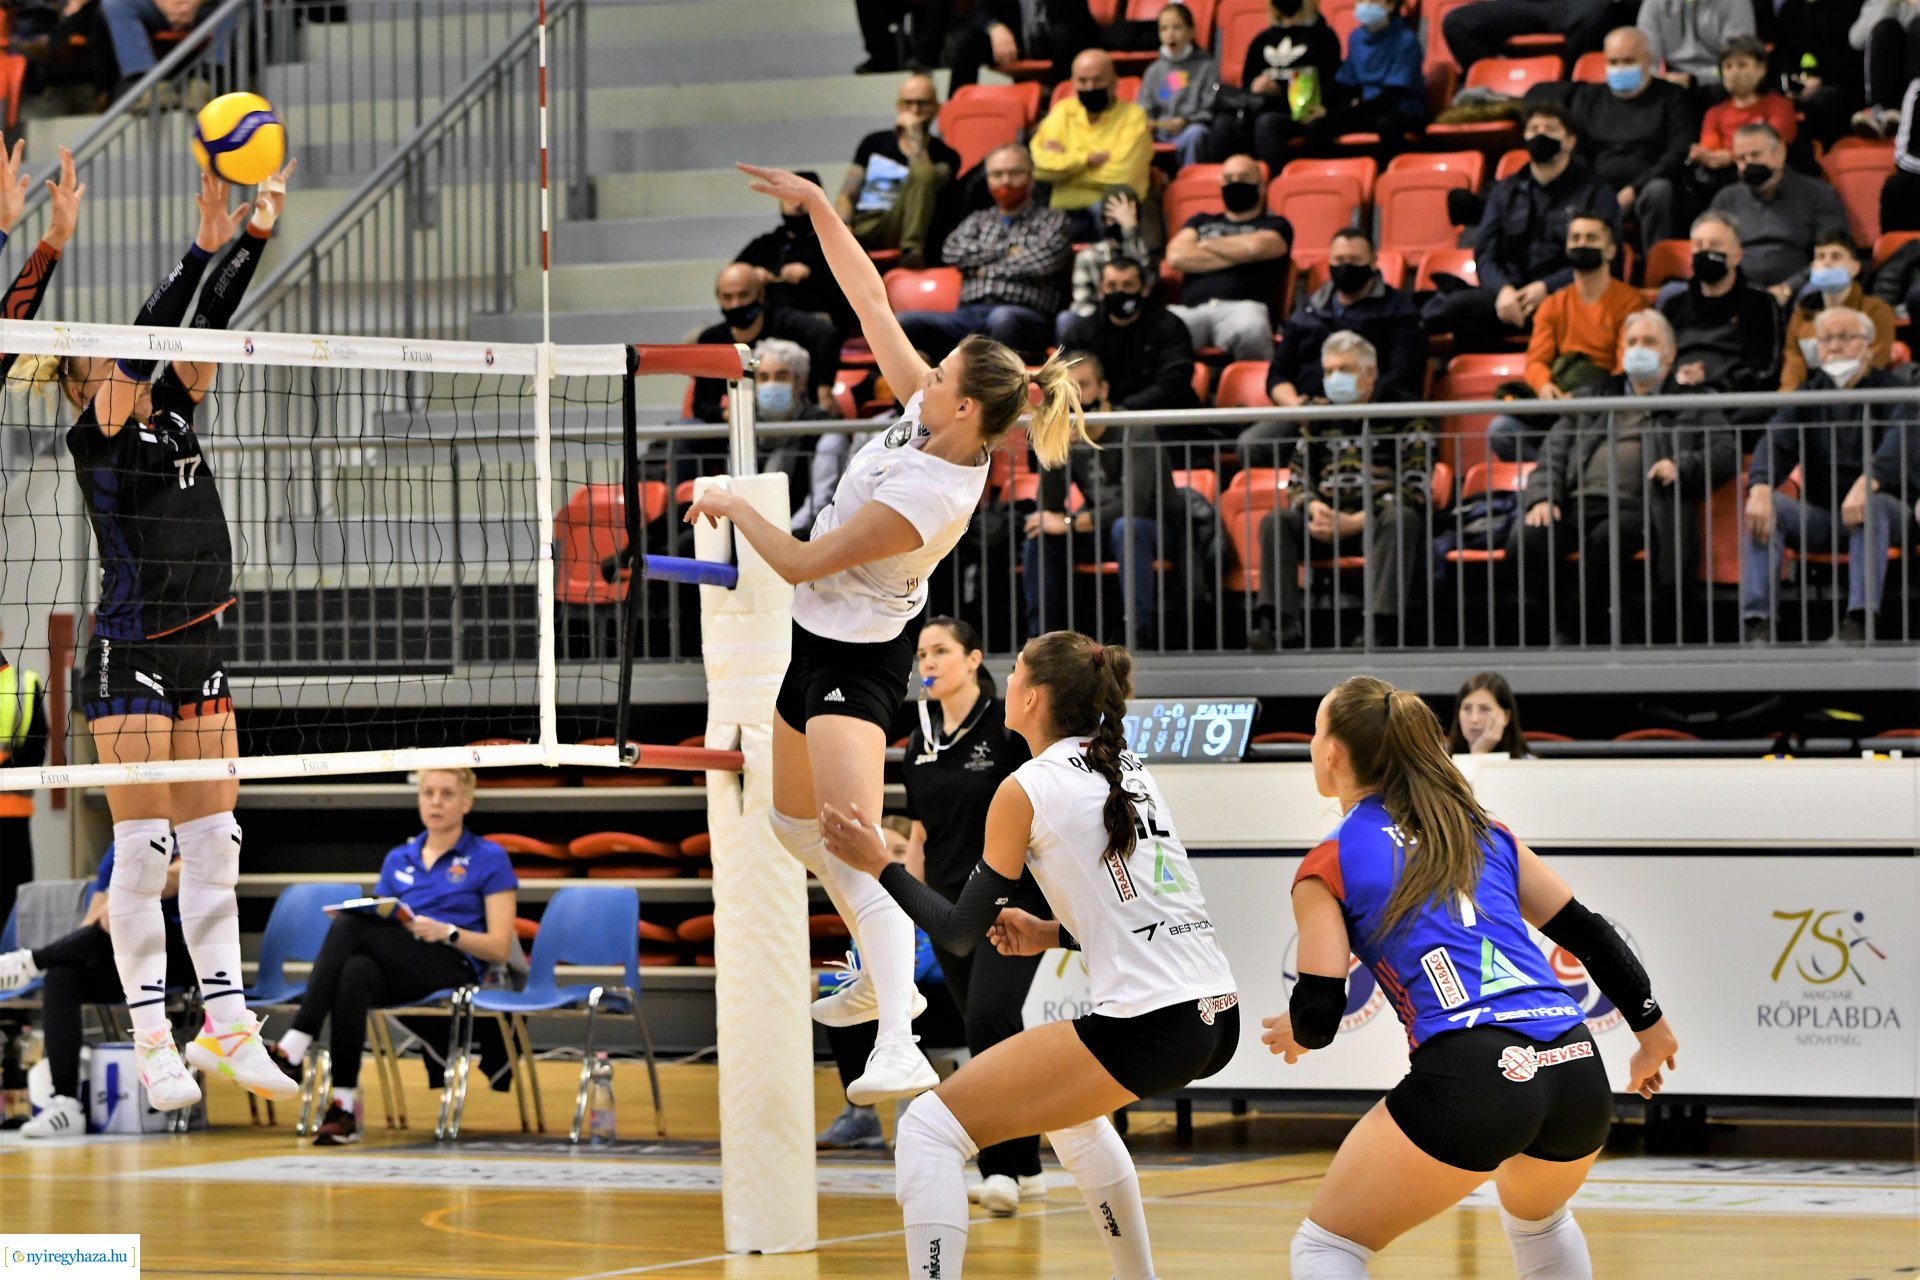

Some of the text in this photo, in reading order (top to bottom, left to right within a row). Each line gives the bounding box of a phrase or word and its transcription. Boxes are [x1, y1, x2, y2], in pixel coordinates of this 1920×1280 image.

[148, 333, 183, 352] FATUM
[401, 345, 433, 363] FATUM
[1196, 703, 1254, 715] FATUM
[1202, 718, 1232, 756] 9
[302, 758, 329, 771] FATUM
[39, 771, 70, 785] FATUM
[1108, 853, 1134, 901] STRABAG
[1430, 953, 1460, 1005] STRABAG
[1213, 992, 1238, 1011] REVES
[1802, 989, 1855, 1001] MAGYAR
[1494, 1006, 1578, 1022] BESTRONG
[1757, 1001, 1902, 1029] RÖPLABDA
[1796, 1033, 1862, 1046] SZÖVETSÉG
[1538, 1043, 1592, 1066] REVESZ
[1099, 1201, 1122, 1237] MIKASA
[922, 1237, 942, 1280] MIKASA
